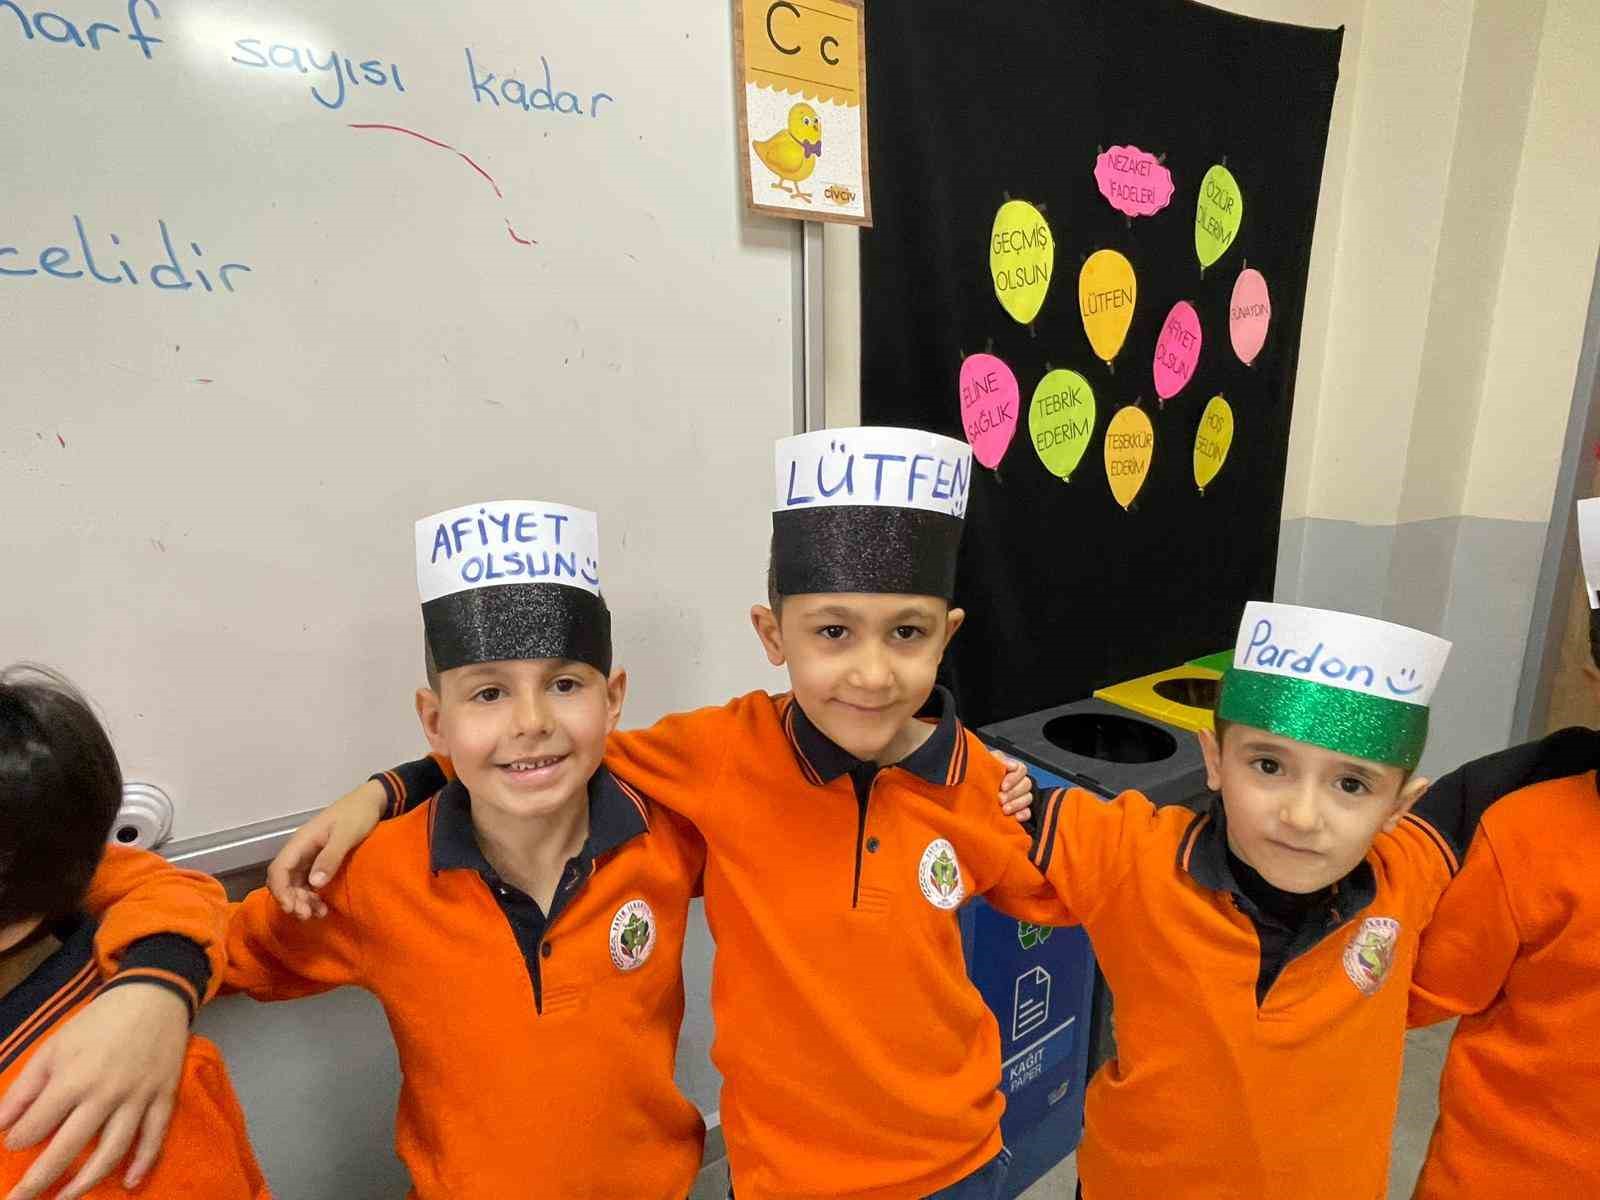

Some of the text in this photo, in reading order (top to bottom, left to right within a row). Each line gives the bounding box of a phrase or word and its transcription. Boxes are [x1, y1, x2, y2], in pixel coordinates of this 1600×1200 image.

[766, 0, 840, 66] C c
[231, 38, 405, 110] sayısı
[464, 47, 614, 118] kadar
[1107, 154, 1153, 177] NEZAKET
[1109, 178, 1156, 204] FADELERİ
[992, 222, 1048, 256] GEÇMİŞ
[996, 264, 1048, 292] OLSUN
[1084, 287, 1133, 317] LÜTFEN
[963, 371, 1000, 408] ELİNE
[1036, 385, 1082, 417] TEBRİK
[967, 402, 1014, 444] SAĞLIK
[1035, 417, 1090, 452] EDERİM
[786, 440, 971, 505] LÜTFEN
[431, 507, 569, 564] AFİYET
[461, 551, 577, 583] OLSUN
[1243, 619, 1375, 687] Pardon
